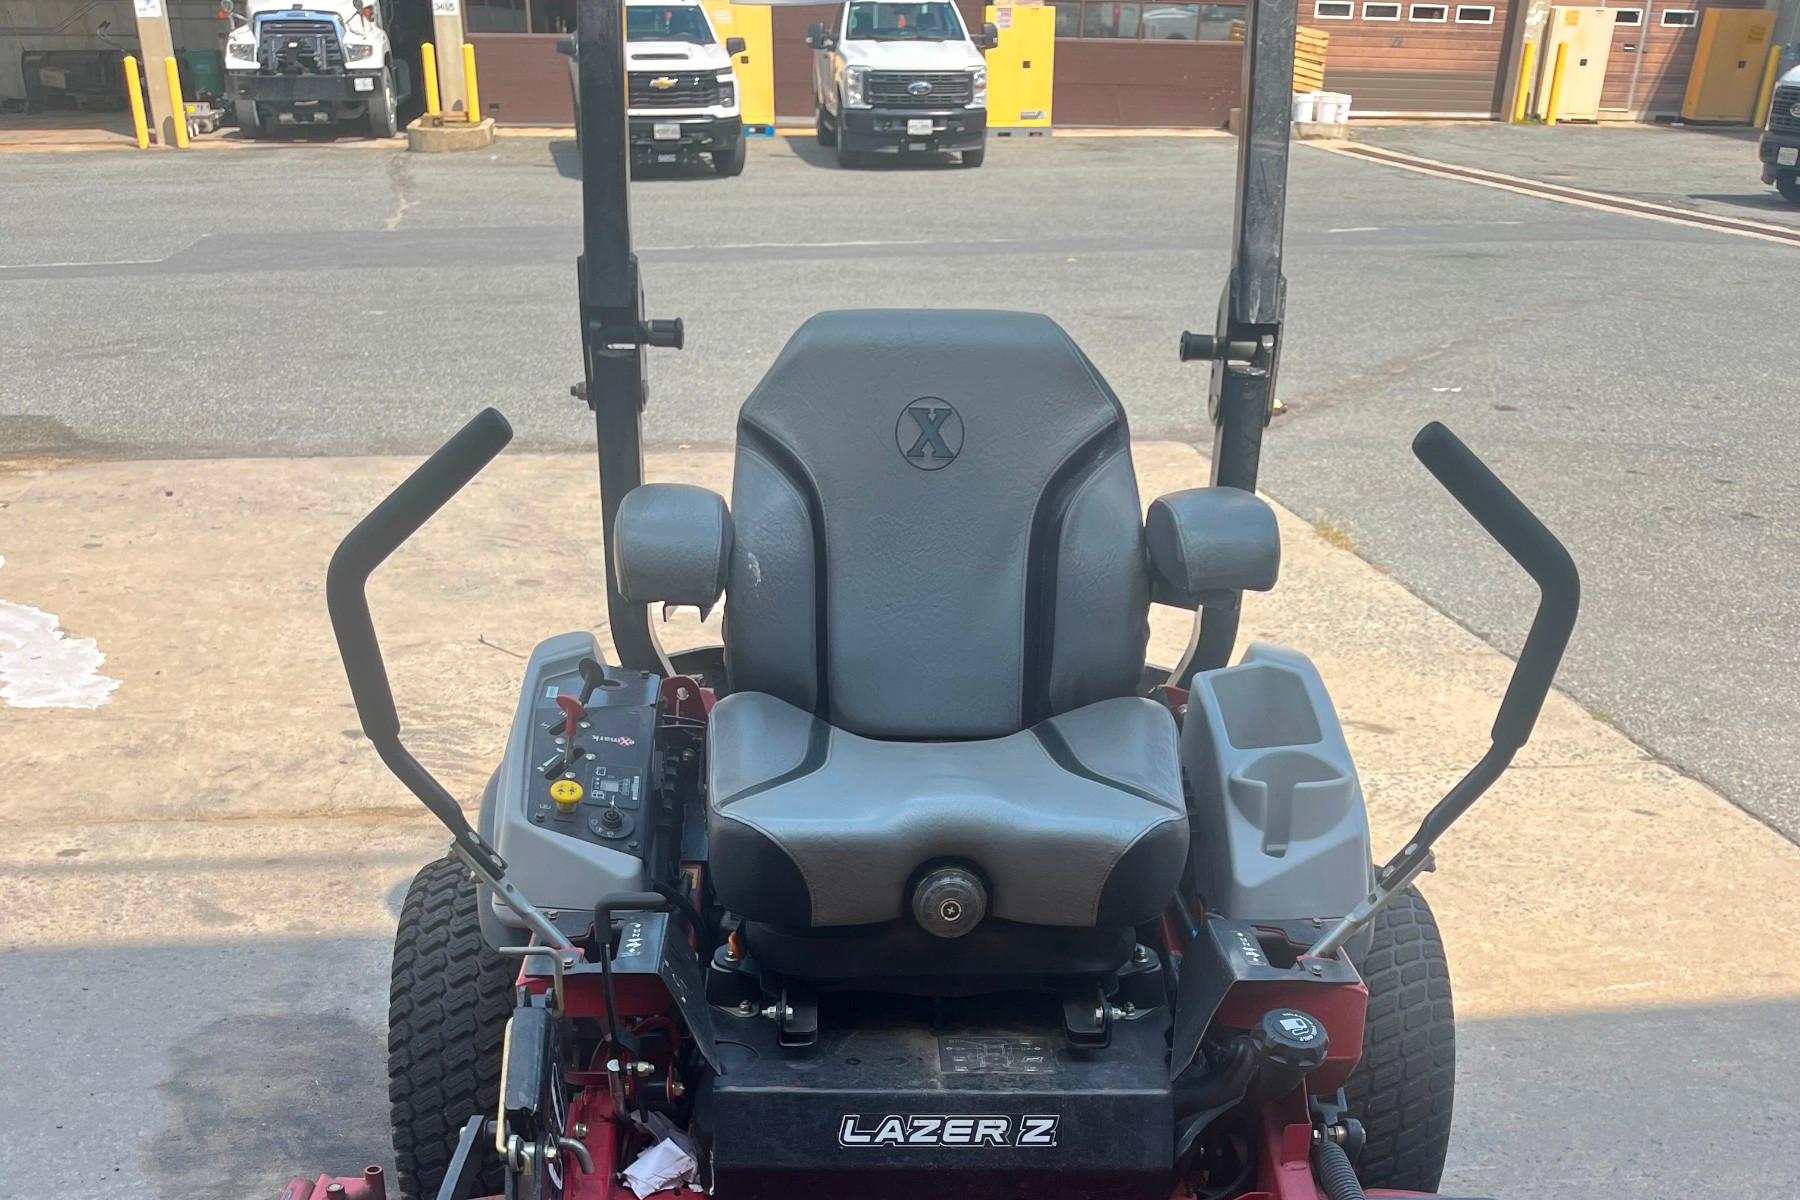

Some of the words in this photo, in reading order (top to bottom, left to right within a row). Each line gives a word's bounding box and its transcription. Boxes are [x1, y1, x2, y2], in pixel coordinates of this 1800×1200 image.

[907, 407, 953, 458] X
[841, 1117, 1007, 1144] LAZER
[1019, 1117, 1057, 1144] Z
